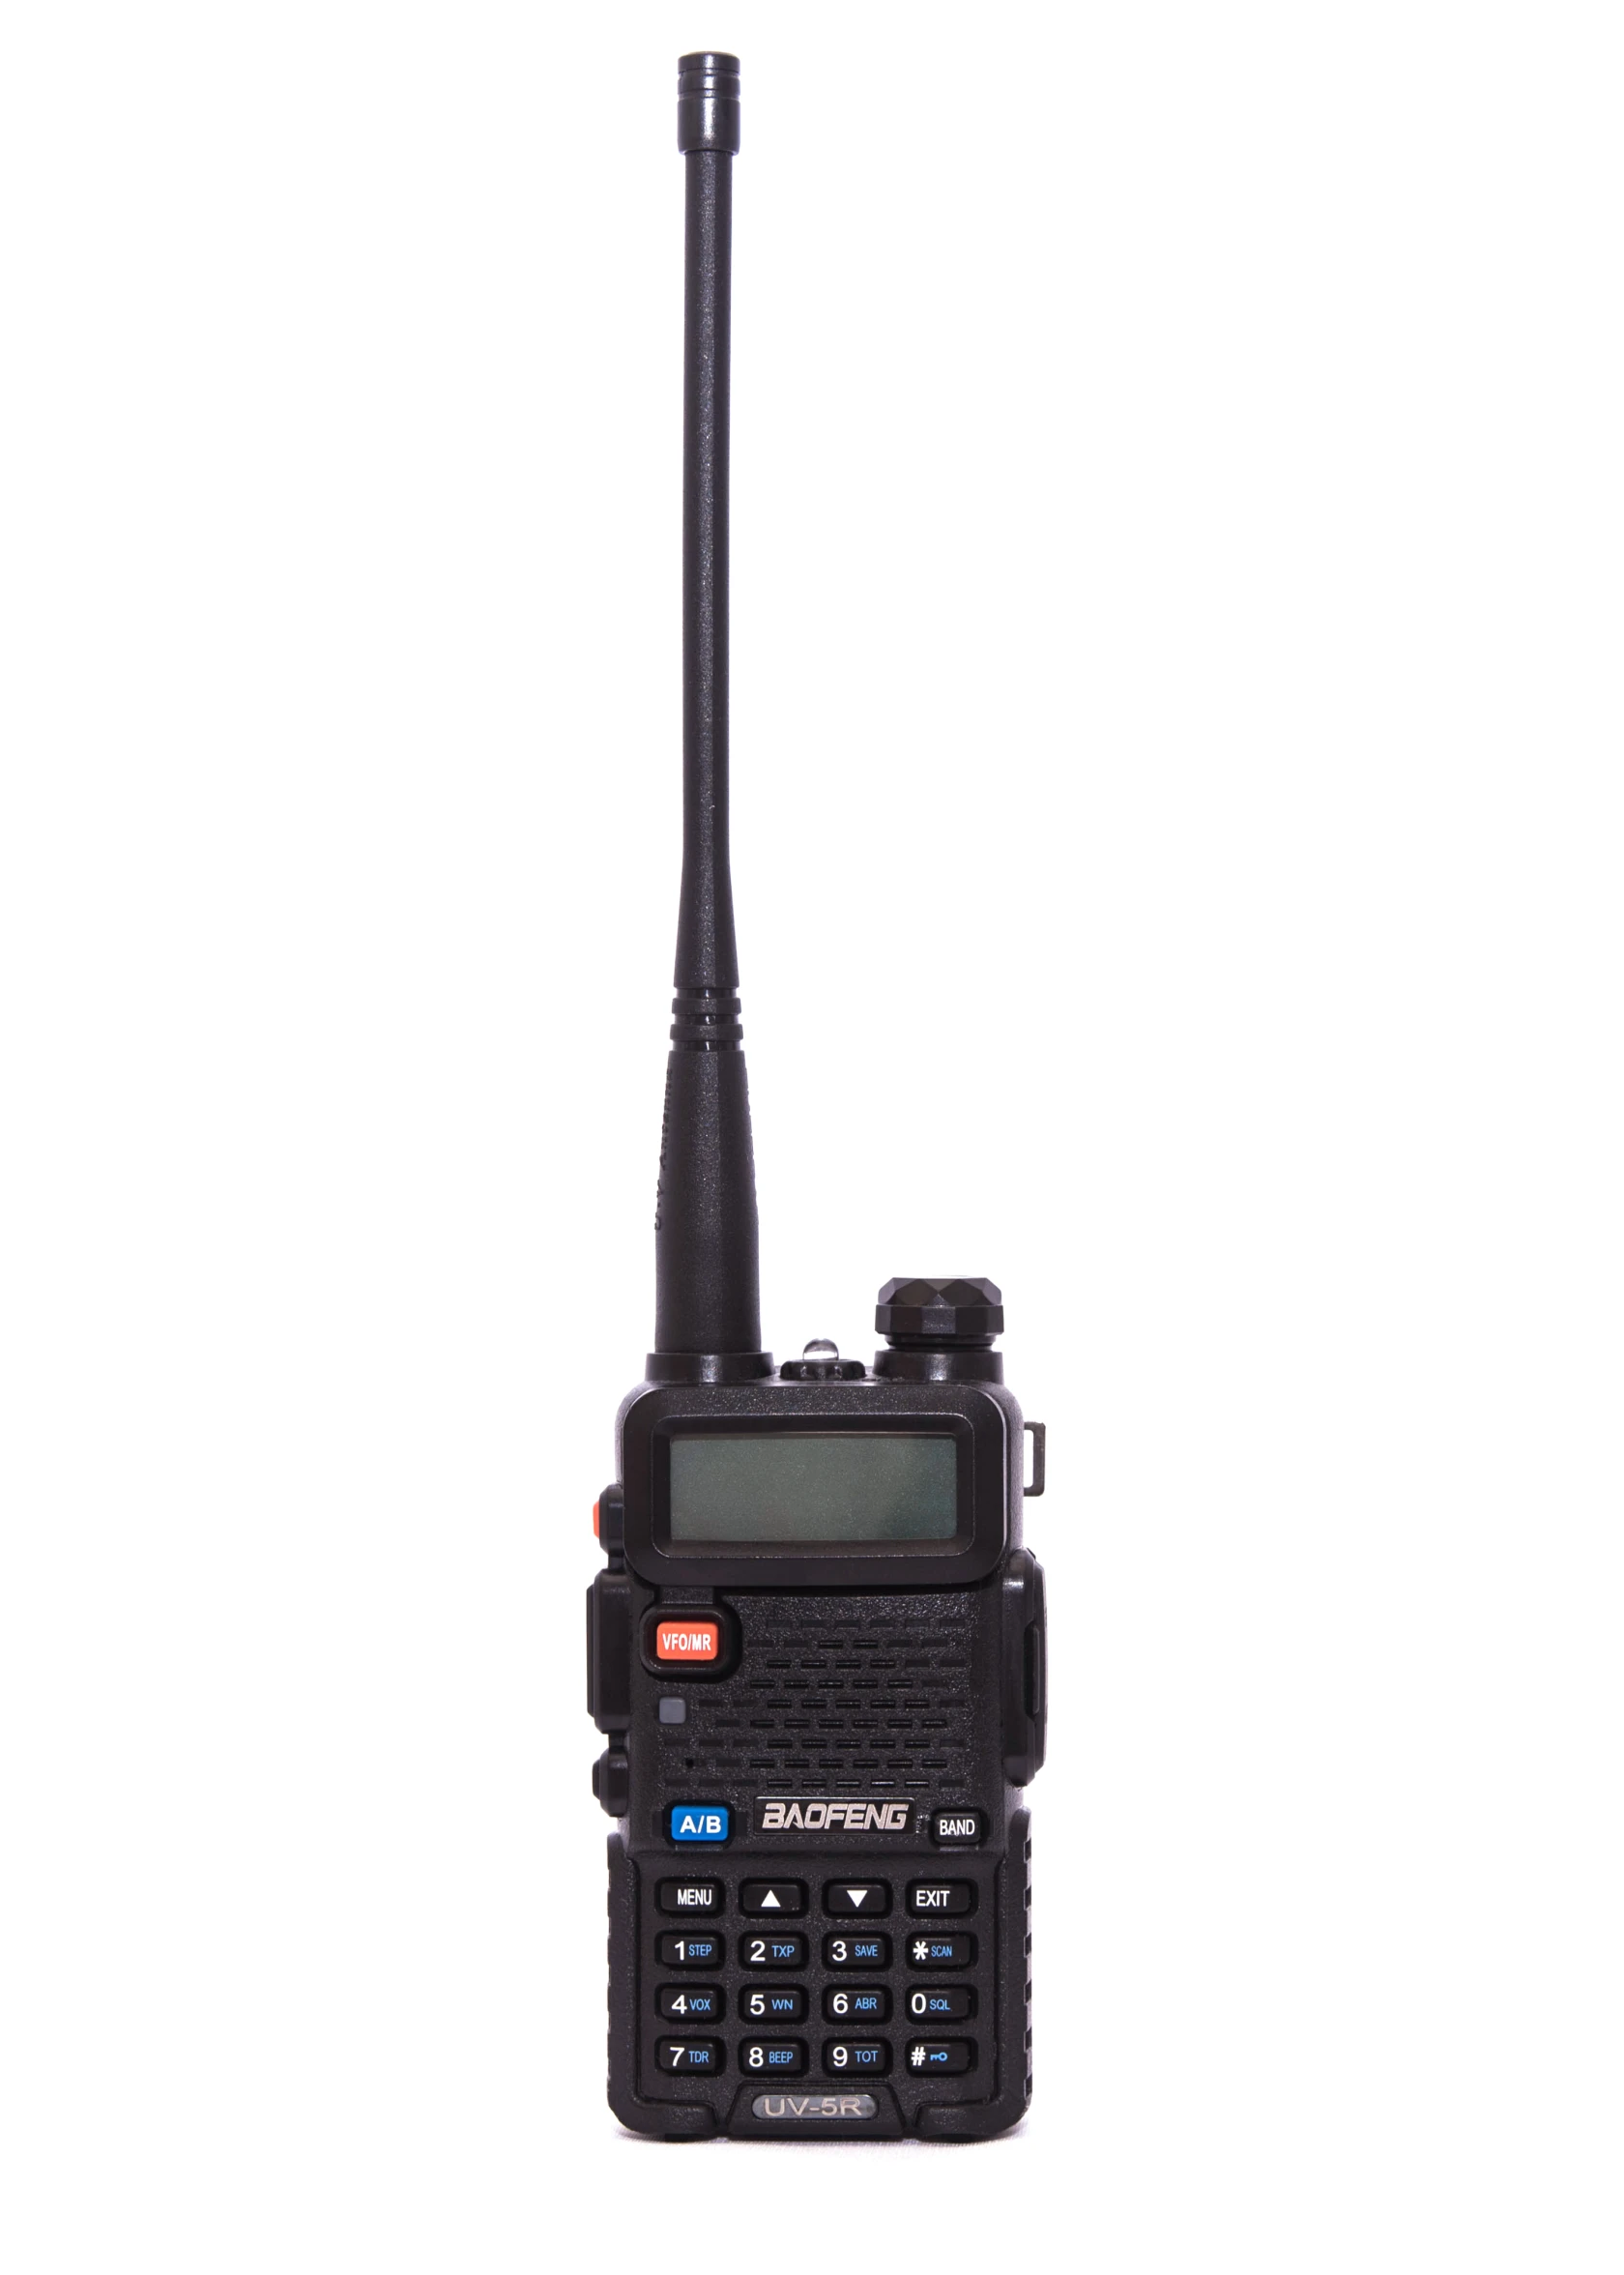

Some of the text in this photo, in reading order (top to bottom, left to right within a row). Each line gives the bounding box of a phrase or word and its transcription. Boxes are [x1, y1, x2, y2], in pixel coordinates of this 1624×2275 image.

[661, 1632, 711, 1651] VFO/MR
[680, 1815, 722, 1834] A/B
[762, 1802, 910, 1830] BAOFENG
[939, 1819, 975, 1837] BAND
[677, 1888, 712, 1906] MENU
[915, 1889, 950, 1908] EXIT
[674, 1940, 712, 1961] 1 STEP
[750, 1940, 795, 1962] 2 TXP
[831, 1940, 878, 1962] 3 SAVE
[931, 1945, 952, 1958] SCAN
[671, 1994, 710, 2015] 4 VOX
[749, 1994, 794, 2016] 5 WN
[832, 1993, 878, 2015] 6 ABR
[911, 1993, 951, 2015] 0 SQL
[669, 2046, 710, 2067] 7 TDR
[748, 2046, 794, 2068] 8 BEEP
[832, 2046, 879, 2067] 9 TOT
[911, 2046, 926, 2067] #
[764, 2097, 862, 2116] UV-5R
